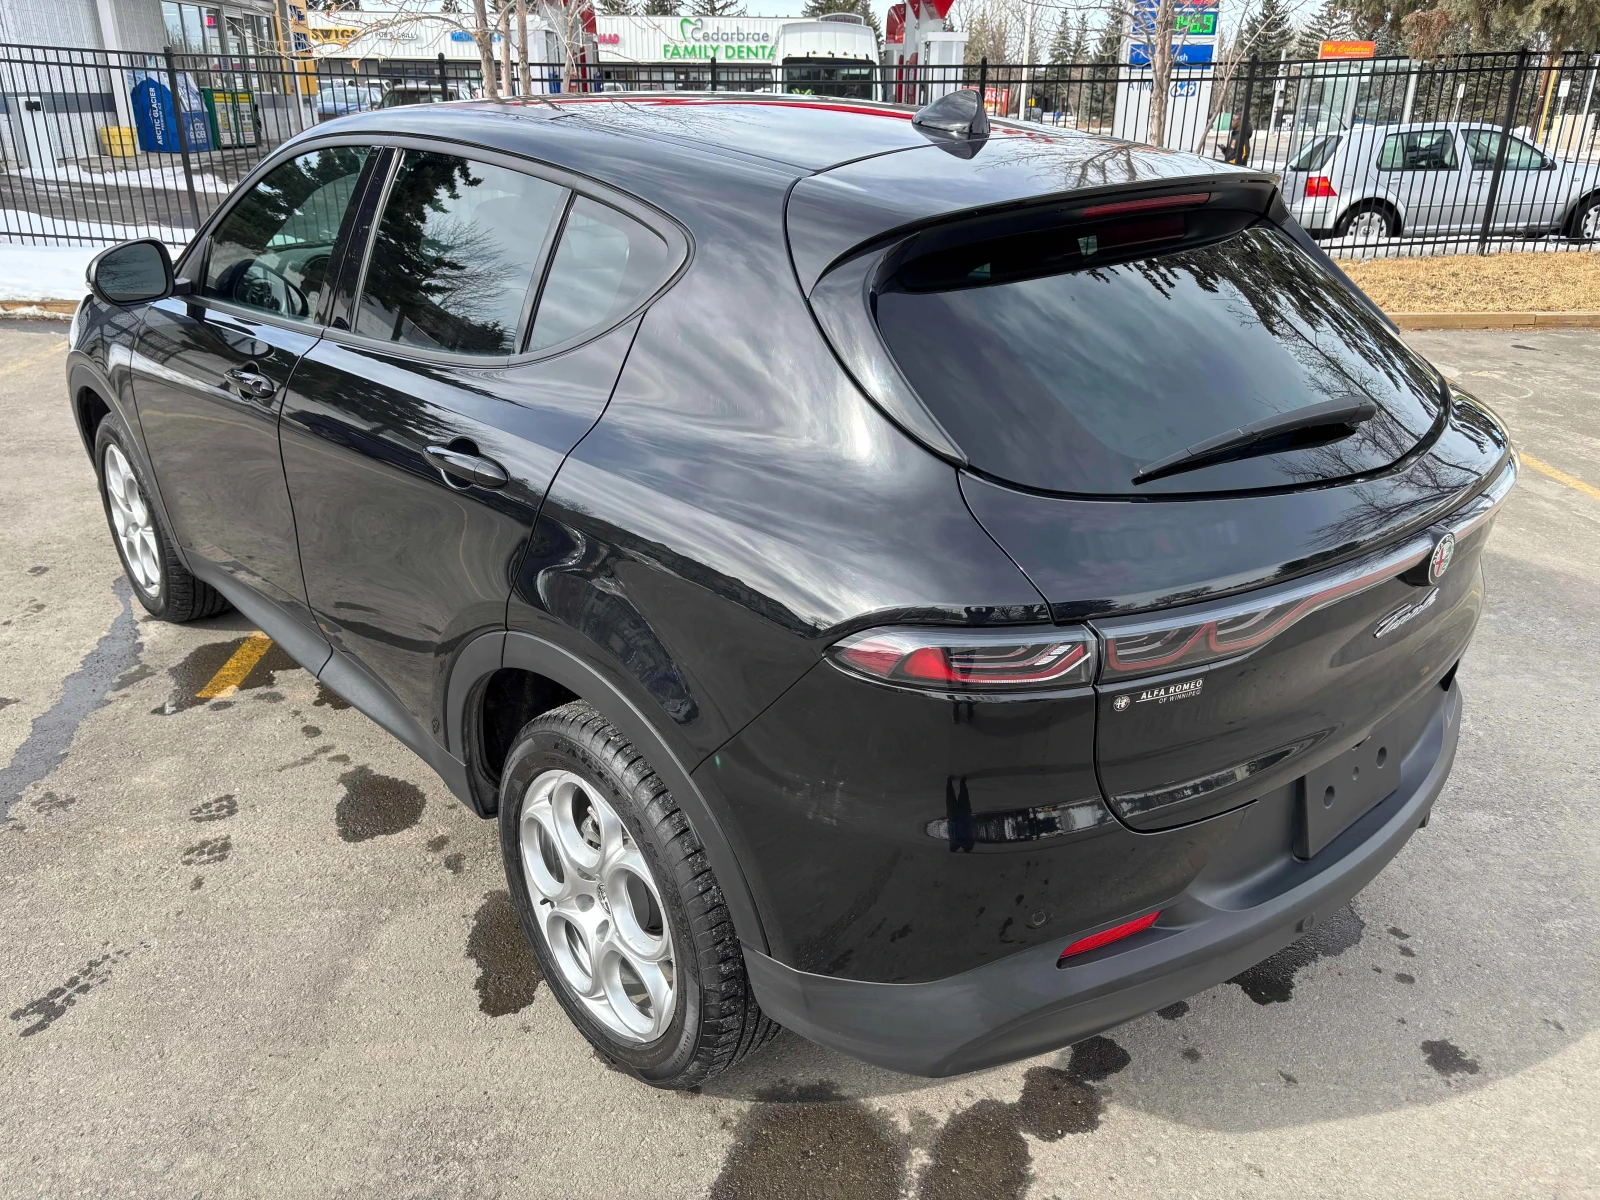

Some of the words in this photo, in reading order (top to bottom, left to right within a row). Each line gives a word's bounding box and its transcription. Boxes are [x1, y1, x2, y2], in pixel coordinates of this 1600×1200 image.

[311, 28, 359, 40] SWIGS
[691, 22, 769, 42] Cedarbrae
[664, 45, 719, 59] FAMILY
[149, 87, 159, 117] GLACIER
[154, 117, 164, 145] ARCTIC
[1140, 688, 1165, 700] ALFA
[1169, 679, 1203, 694] ROMEO
[1169, 689, 1201, 702] WINNIPEG
